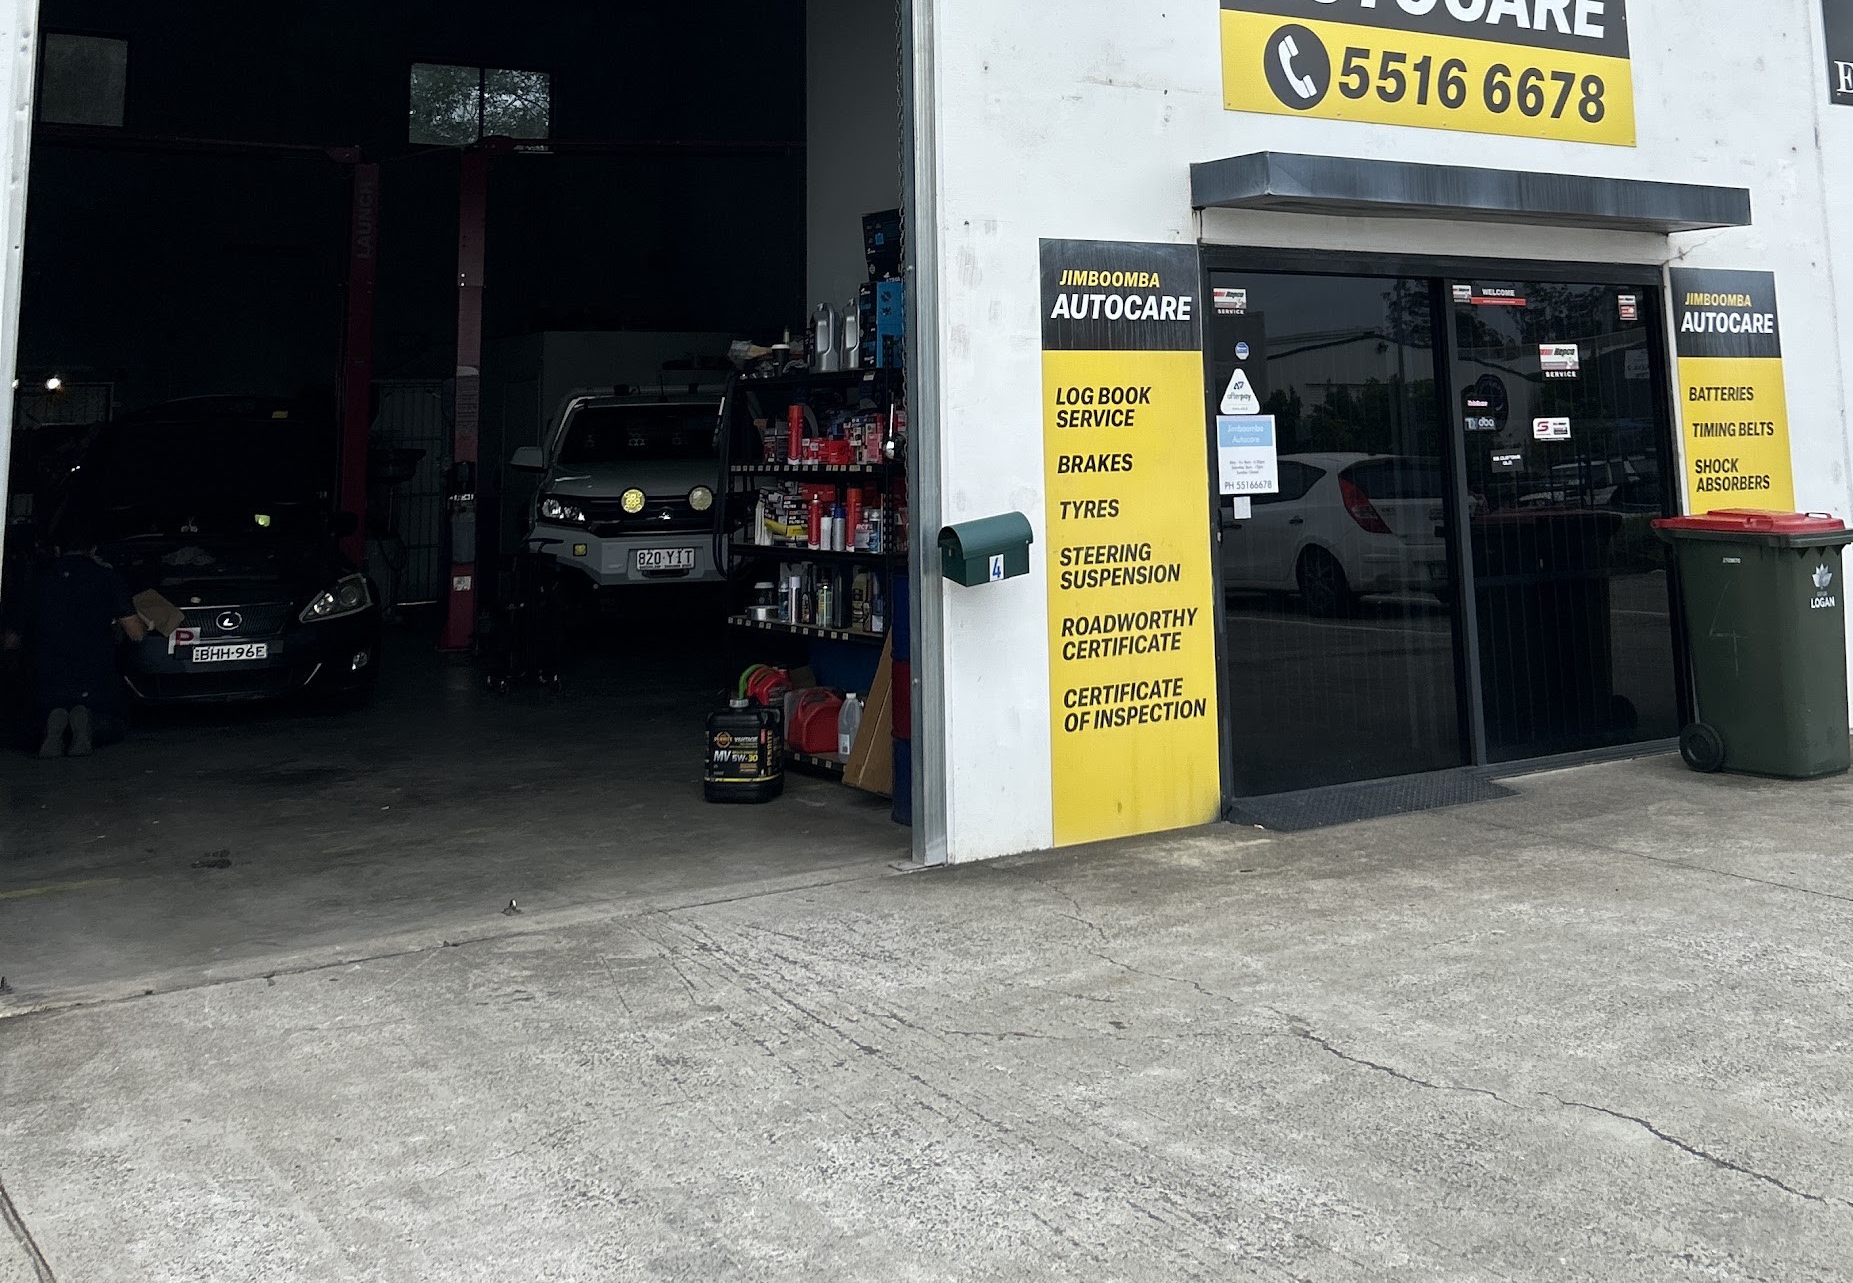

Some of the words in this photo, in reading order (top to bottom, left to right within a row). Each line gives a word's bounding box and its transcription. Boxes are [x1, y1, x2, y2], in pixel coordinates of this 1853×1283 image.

[1338, 47, 1468, 110] 5516
[1482, 64, 1606, 124] 6678
[1059, 270, 1161, 288] JIMBOOMBA
[1482, 288, 1515, 297] WELCOME
[1685, 292, 1752, 308] JIMBOOMBA
[1050, 294, 1192, 321] AUTOCARE
[1681, 312, 1774, 335] AUTOCARE
[1056, 387, 1094, 405] LOG
[1098, 387, 1152, 405] BOOK
[1689, 386, 1754, 402] BATTERIES
[1056, 409, 1135, 428] SERVICE
[1227, 424, 1264, 433] Jimboomba
[1692, 422, 1736, 438] TIMING
[1738, 421, 1774, 437] BELTS
[1232, 435, 1260, 444] Autocare
[1057, 453, 1133, 474] BRAKES
[1695, 458, 1739, 474] SHOCK
[1224, 482, 1235, 490] PH
[1236, 480, 1272, 490] 55166678
[1696, 474, 1770, 493] ABSORBERS
[1059, 499, 1120, 520] TYRES
[1059, 543, 1151, 566] STEERING
[992, 557, 1002, 578] 4
[1060, 564, 1181, 590] SUSPENSION
[1810, 595, 1836, 609] LOGAN
[1061, 608, 1198, 637] ROADWORTHY
[175, 630, 194, 646] P
[1062, 632, 1182, 661] CERTIFICATE
[1064, 678, 1184, 708] CERTIFICATE
[1064, 712, 1090, 733] OF
[1094, 698, 1207, 730] INSPECTION
